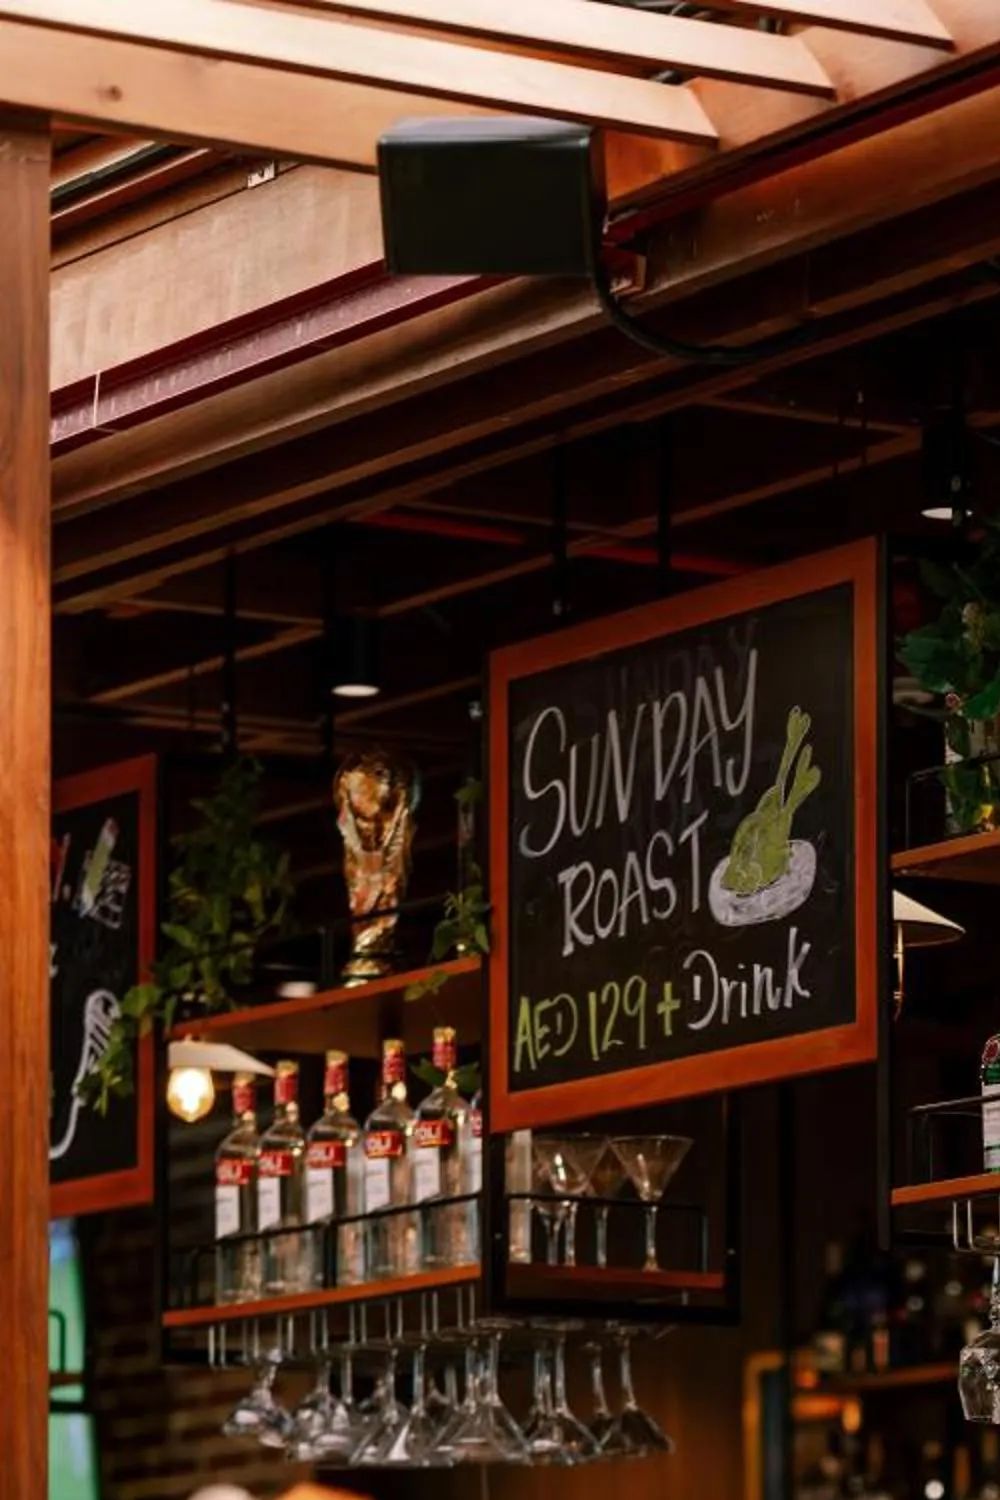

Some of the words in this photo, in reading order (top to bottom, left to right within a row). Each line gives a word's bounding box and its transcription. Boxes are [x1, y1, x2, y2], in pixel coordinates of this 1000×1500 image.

[519, 648, 758, 858] SUNDAY
[557, 809, 710, 957] ROAST
[513, 992, 579, 1074] AED
[587, 975, 647, 1062] 129
[683, 926, 812, 1030] Drink
